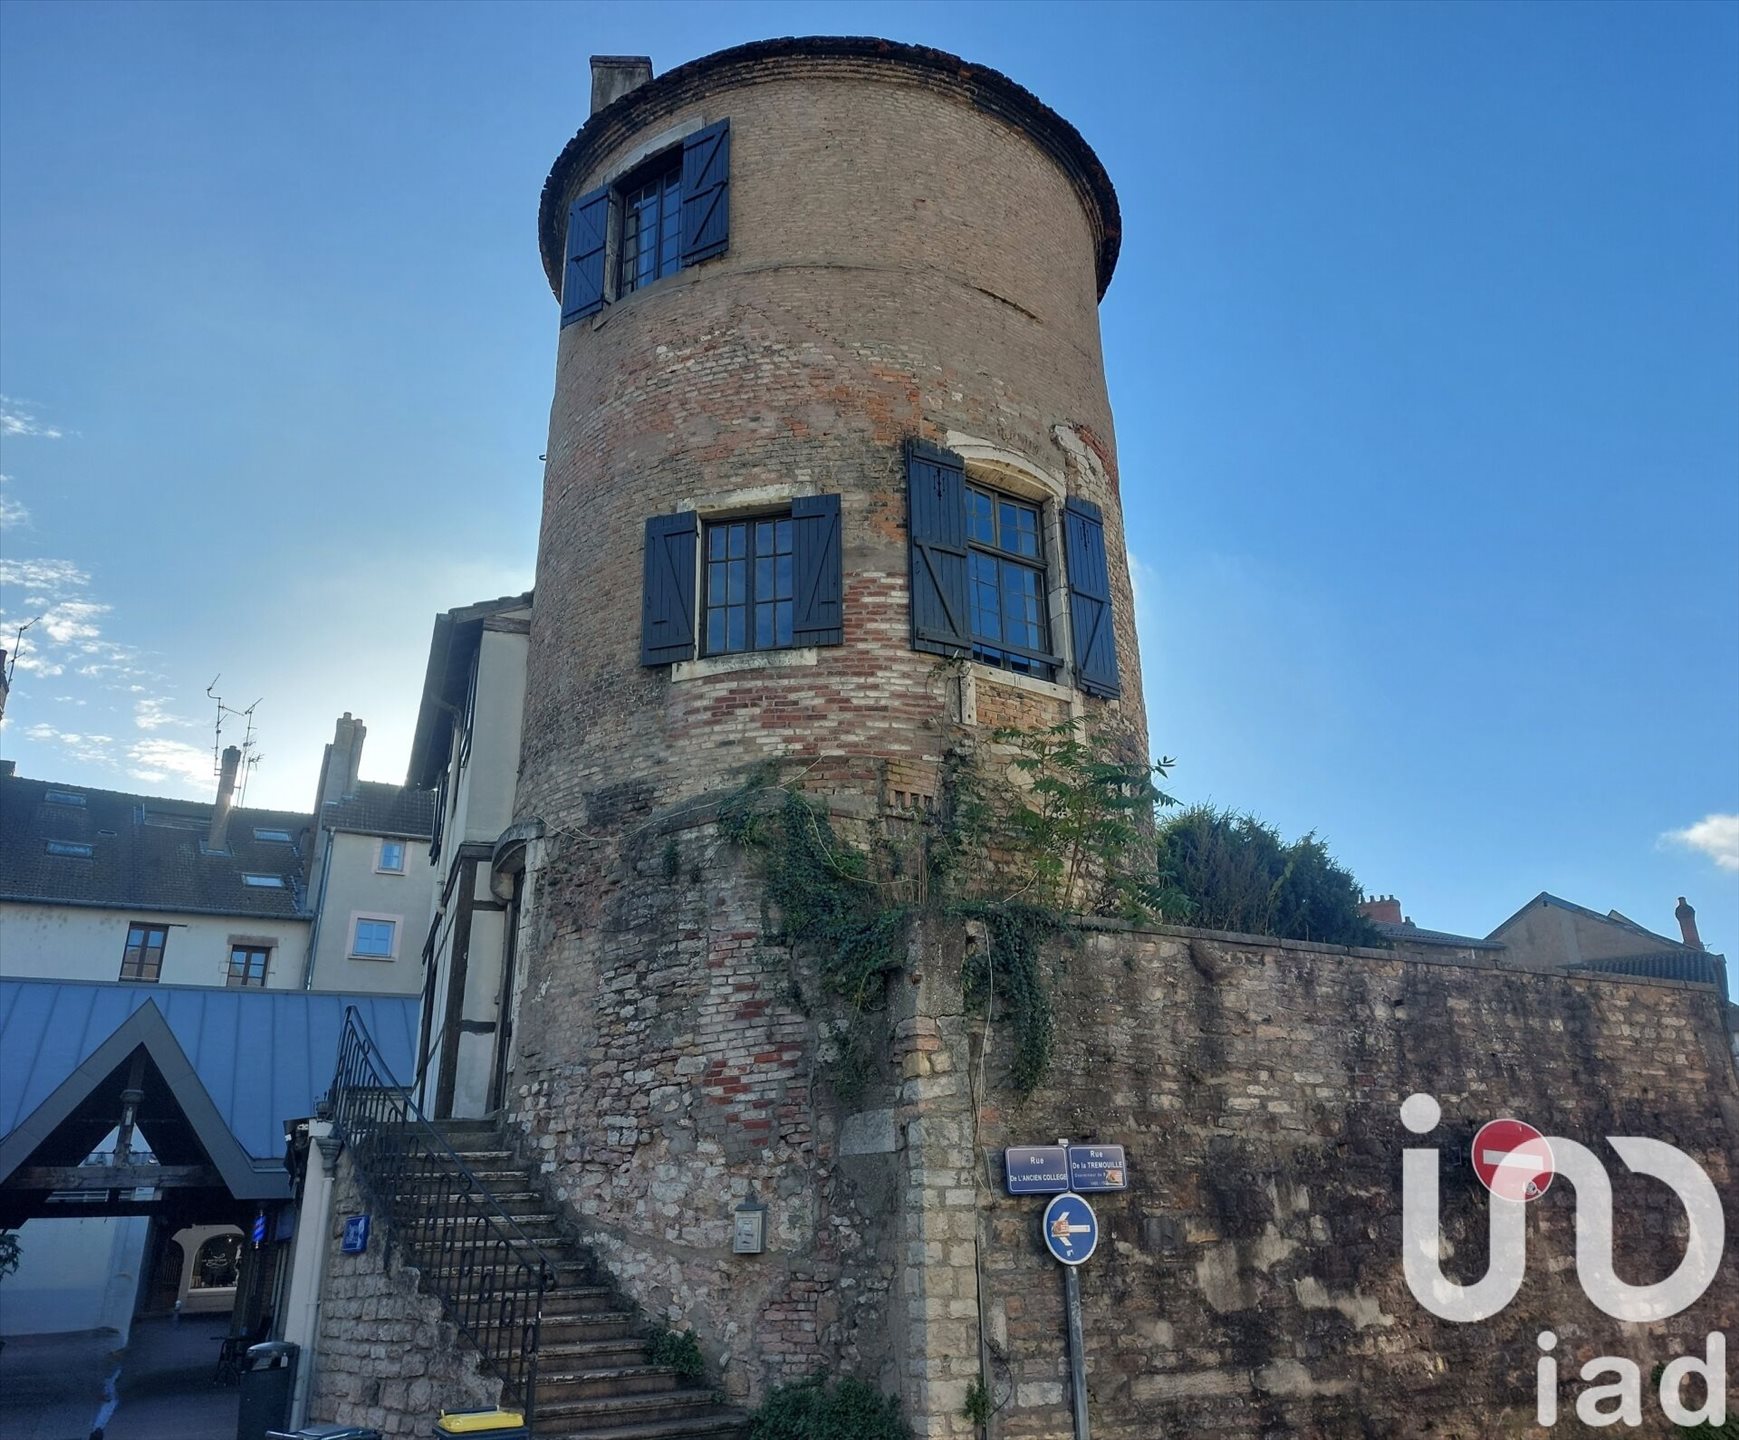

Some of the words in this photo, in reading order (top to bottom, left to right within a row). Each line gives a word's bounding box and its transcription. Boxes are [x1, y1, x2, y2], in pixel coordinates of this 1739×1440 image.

[1090, 1150, 1103, 1158] Rue
[1030, 1156, 1044, 1164] Rue
[1080, 1161, 1086, 1169] la
[1087, 1161, 1122, 1169] TREMOUILLE
[1018, 1174, 1042, 1182] L'ANCIEN
[1043, 1173, 1067, 1181] COLLEGE
